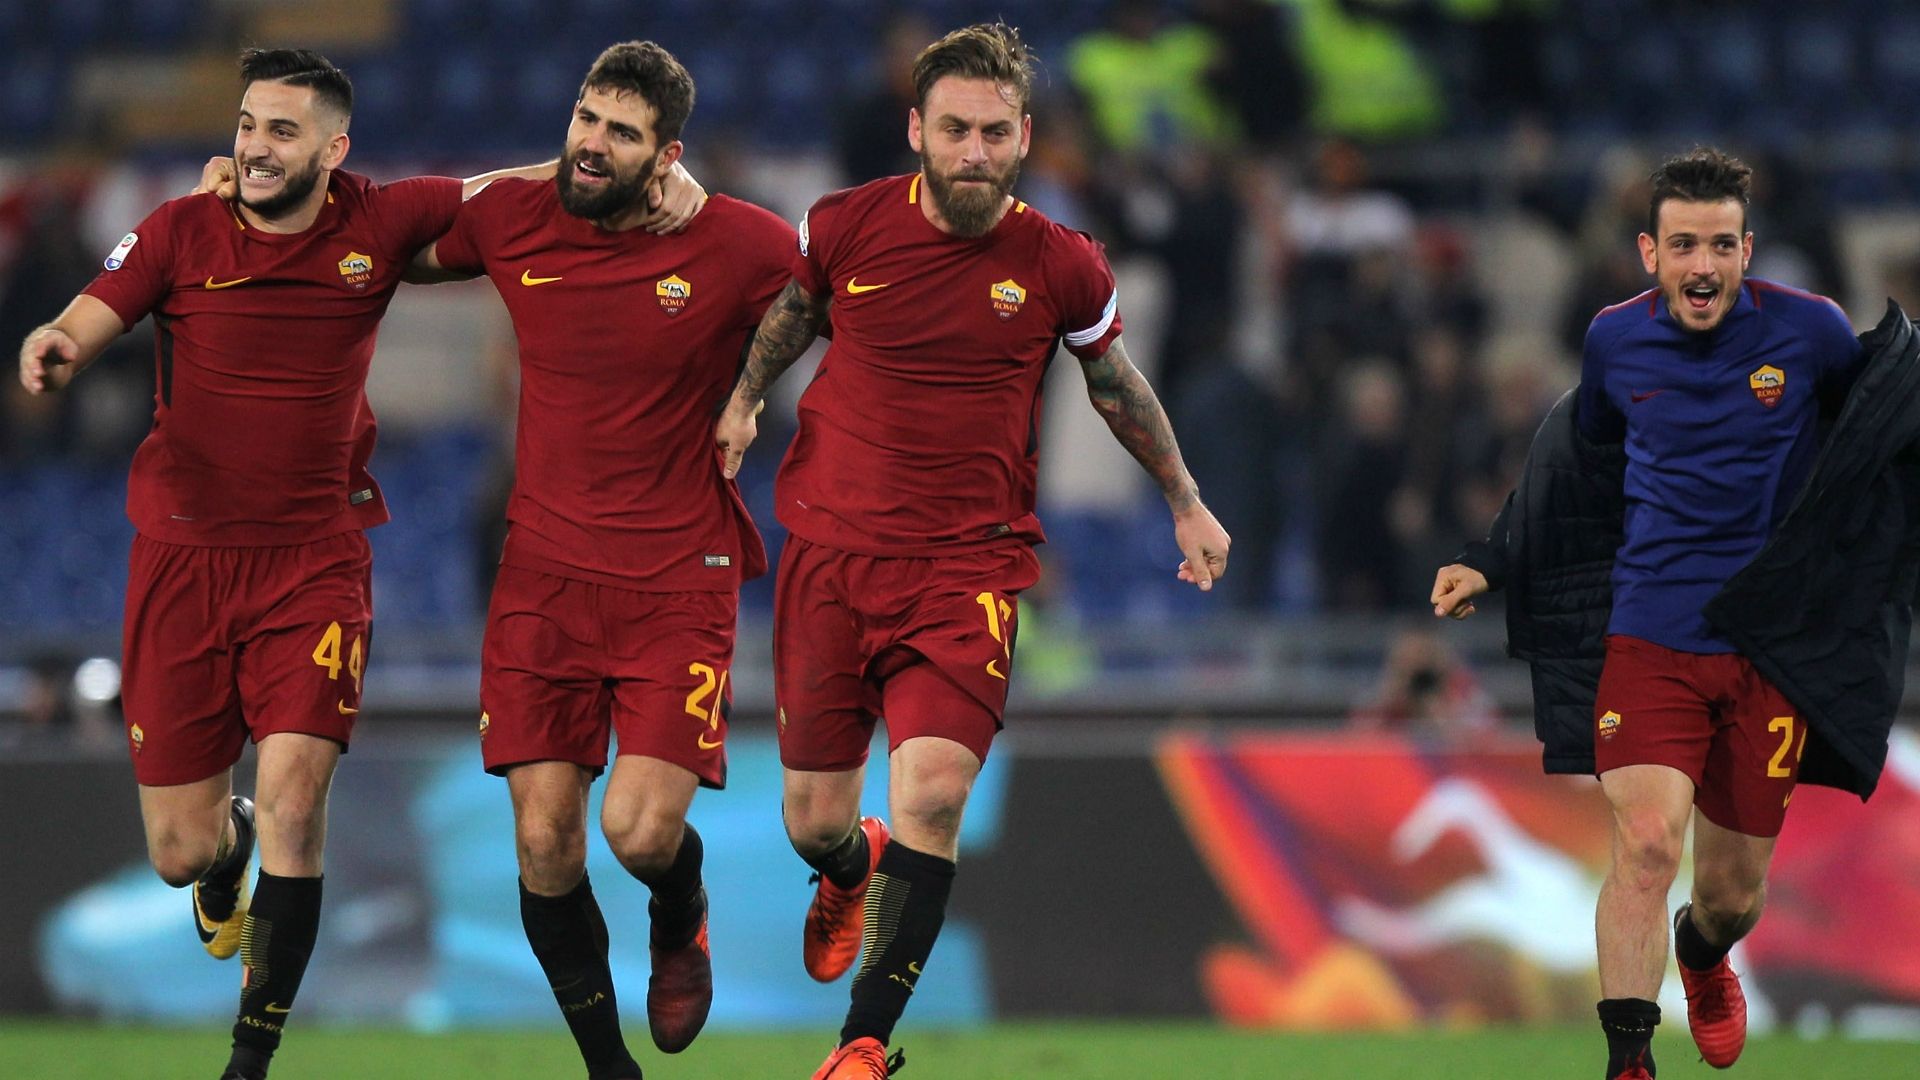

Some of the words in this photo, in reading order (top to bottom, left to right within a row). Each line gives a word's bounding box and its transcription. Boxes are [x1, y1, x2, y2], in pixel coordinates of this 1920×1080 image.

[346, 275, 370, 284] ROMA
[660, 298, 685, 307] ROMA
[993, 301, 1018, 312] ROMA
[1757, 389, 1782, 398] ROMA
[312, 620, 363, 693] 44
[1600, 727, 1617, 736] ROMA
[563, 992, 605, 1012] OMA
